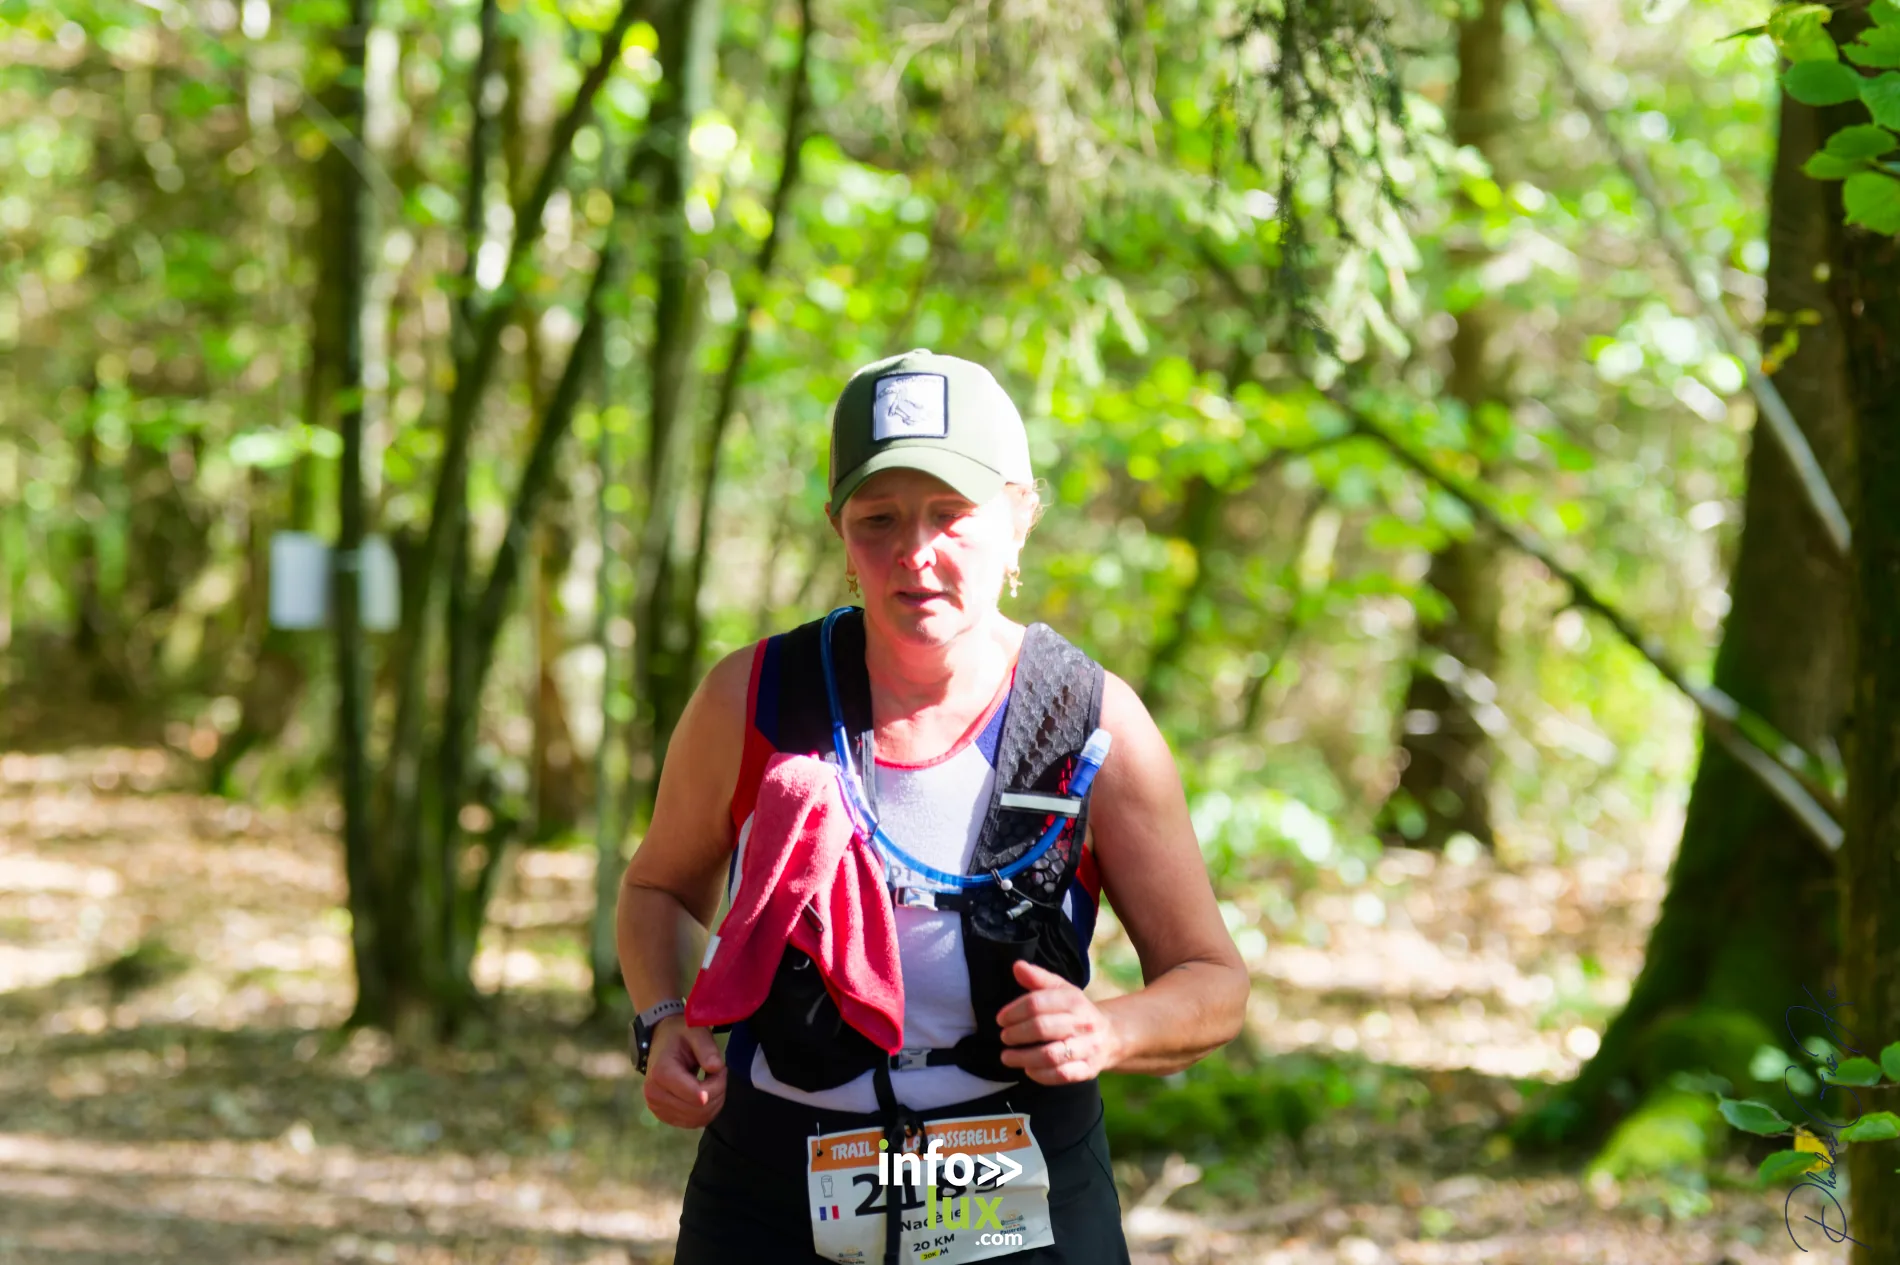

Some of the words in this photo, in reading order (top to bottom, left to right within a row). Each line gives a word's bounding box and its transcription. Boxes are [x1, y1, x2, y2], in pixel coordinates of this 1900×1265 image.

[830, 1140, 875, 1160] TRAIL
[913, 1241, 930, 1252] 20
[934, 1233, 955, 1247] KM
